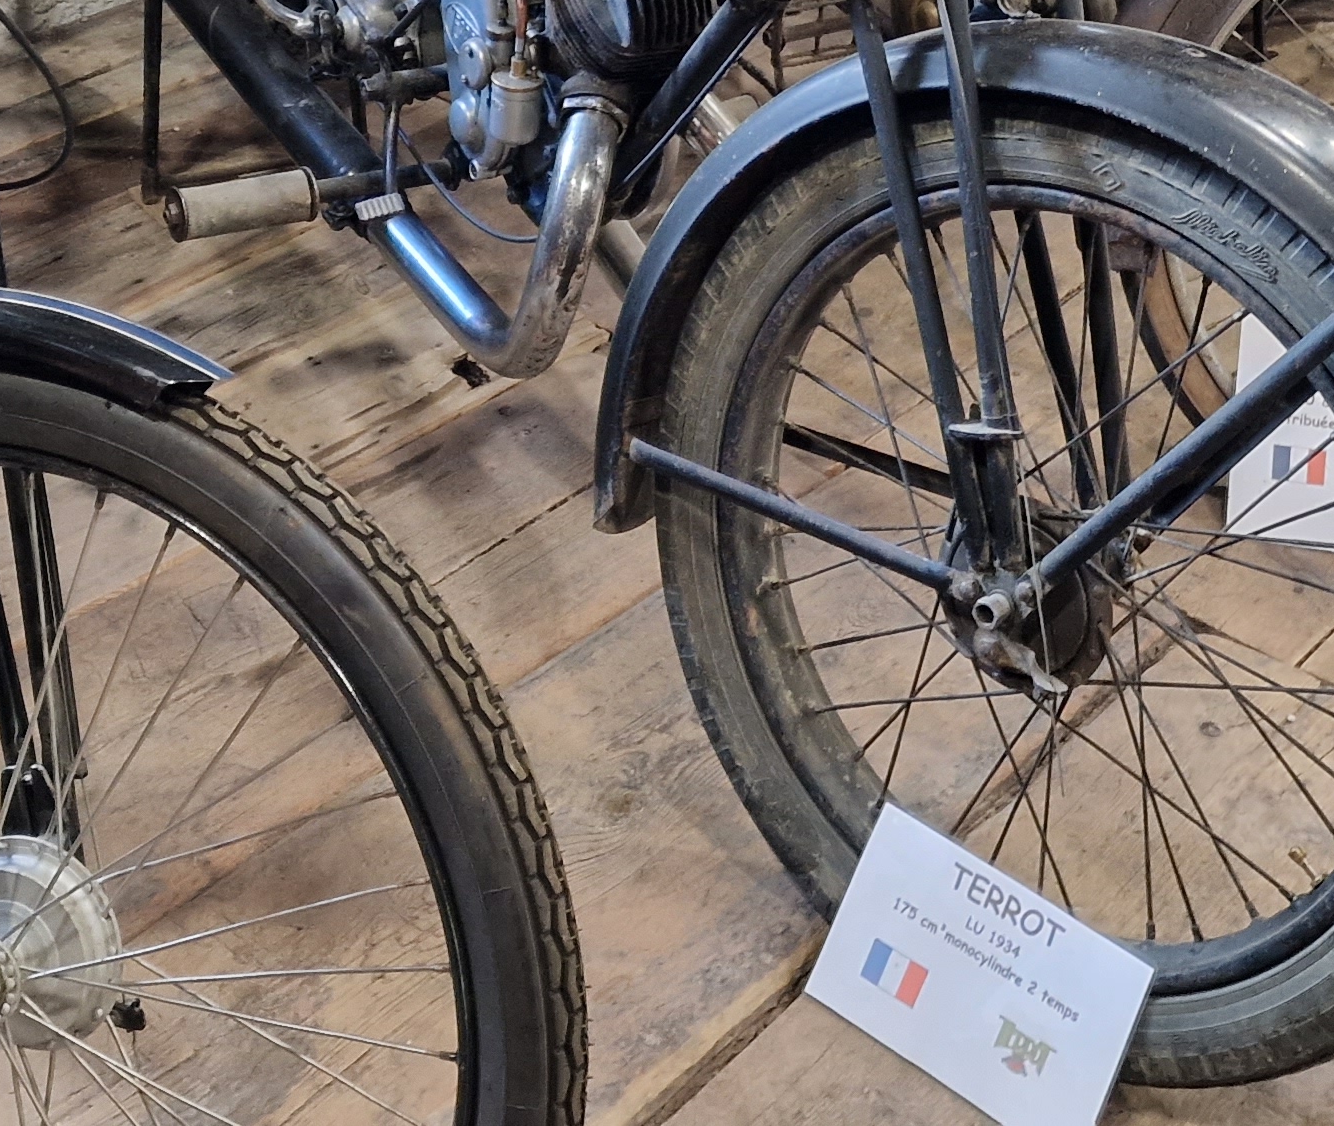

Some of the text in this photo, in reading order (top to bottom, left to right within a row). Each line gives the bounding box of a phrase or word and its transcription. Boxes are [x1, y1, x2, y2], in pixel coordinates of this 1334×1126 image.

[952, 861, 1066, 948] TERROT
[964, 915, 1022, 960] LU 1934
[892, 897, 919, 921] 175
[943, 931, 1023, 988] monocylindre
[1027, 981, 1038, 996] 2
[1041, 990, 1080, 1023] temps
